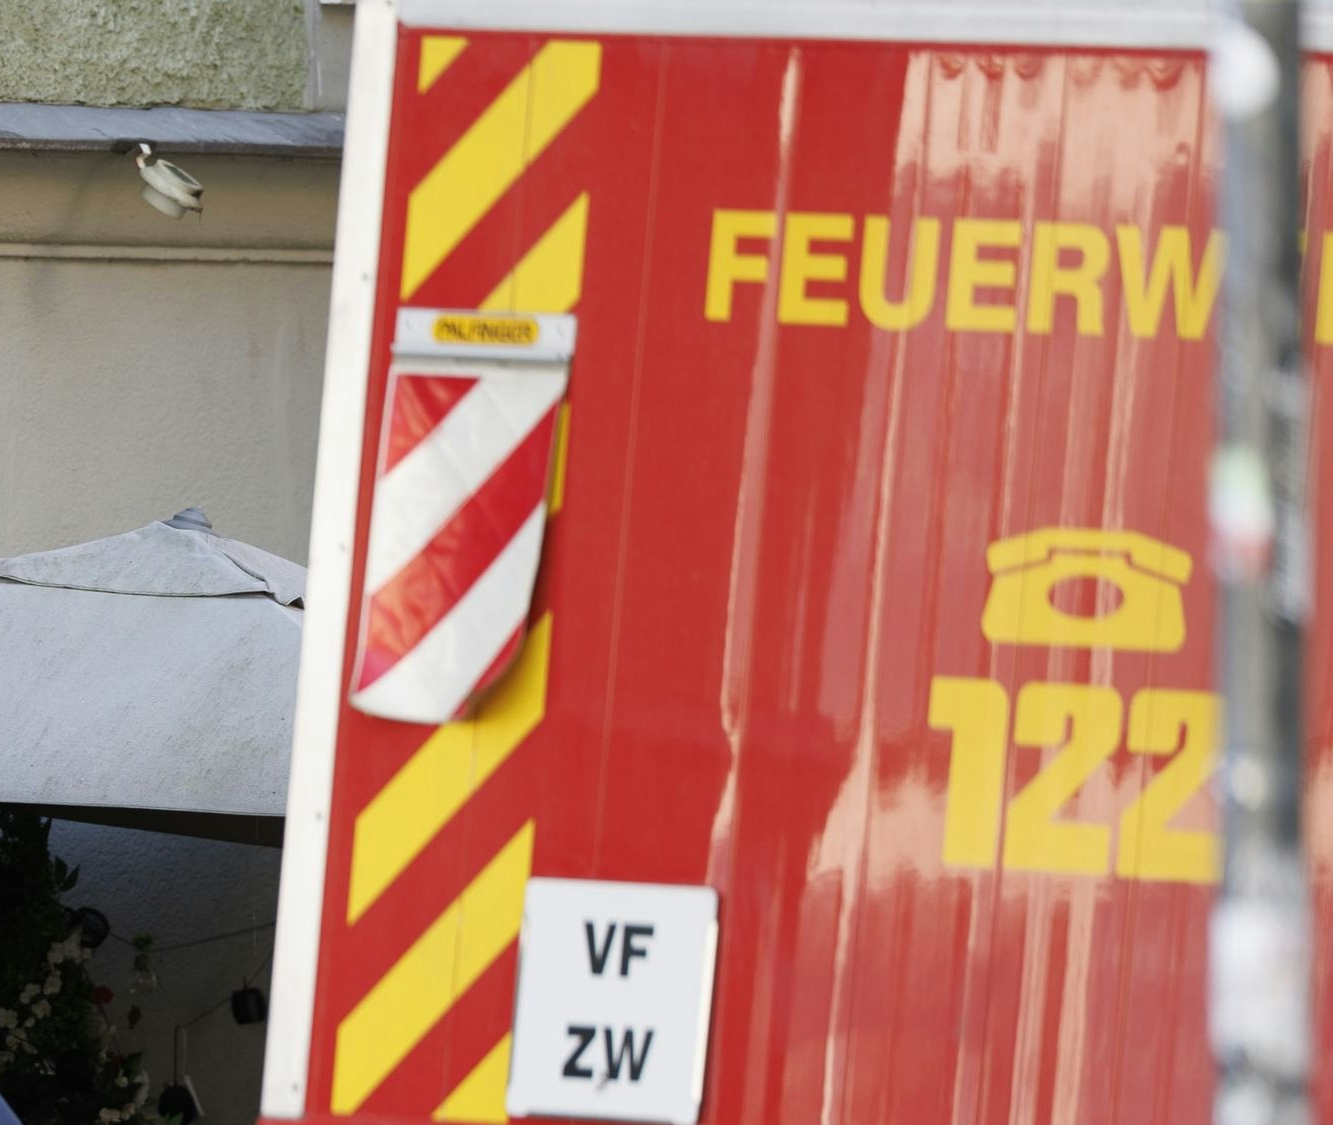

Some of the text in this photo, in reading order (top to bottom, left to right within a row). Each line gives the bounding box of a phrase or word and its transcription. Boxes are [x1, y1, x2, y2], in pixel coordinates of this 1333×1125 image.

[704, 208, 1333, 346] FEUERW
[927, 674, 1226, 884] 122
[584, 920, 656, 978] VF
[561, 1024, 655, 1083] ZW
